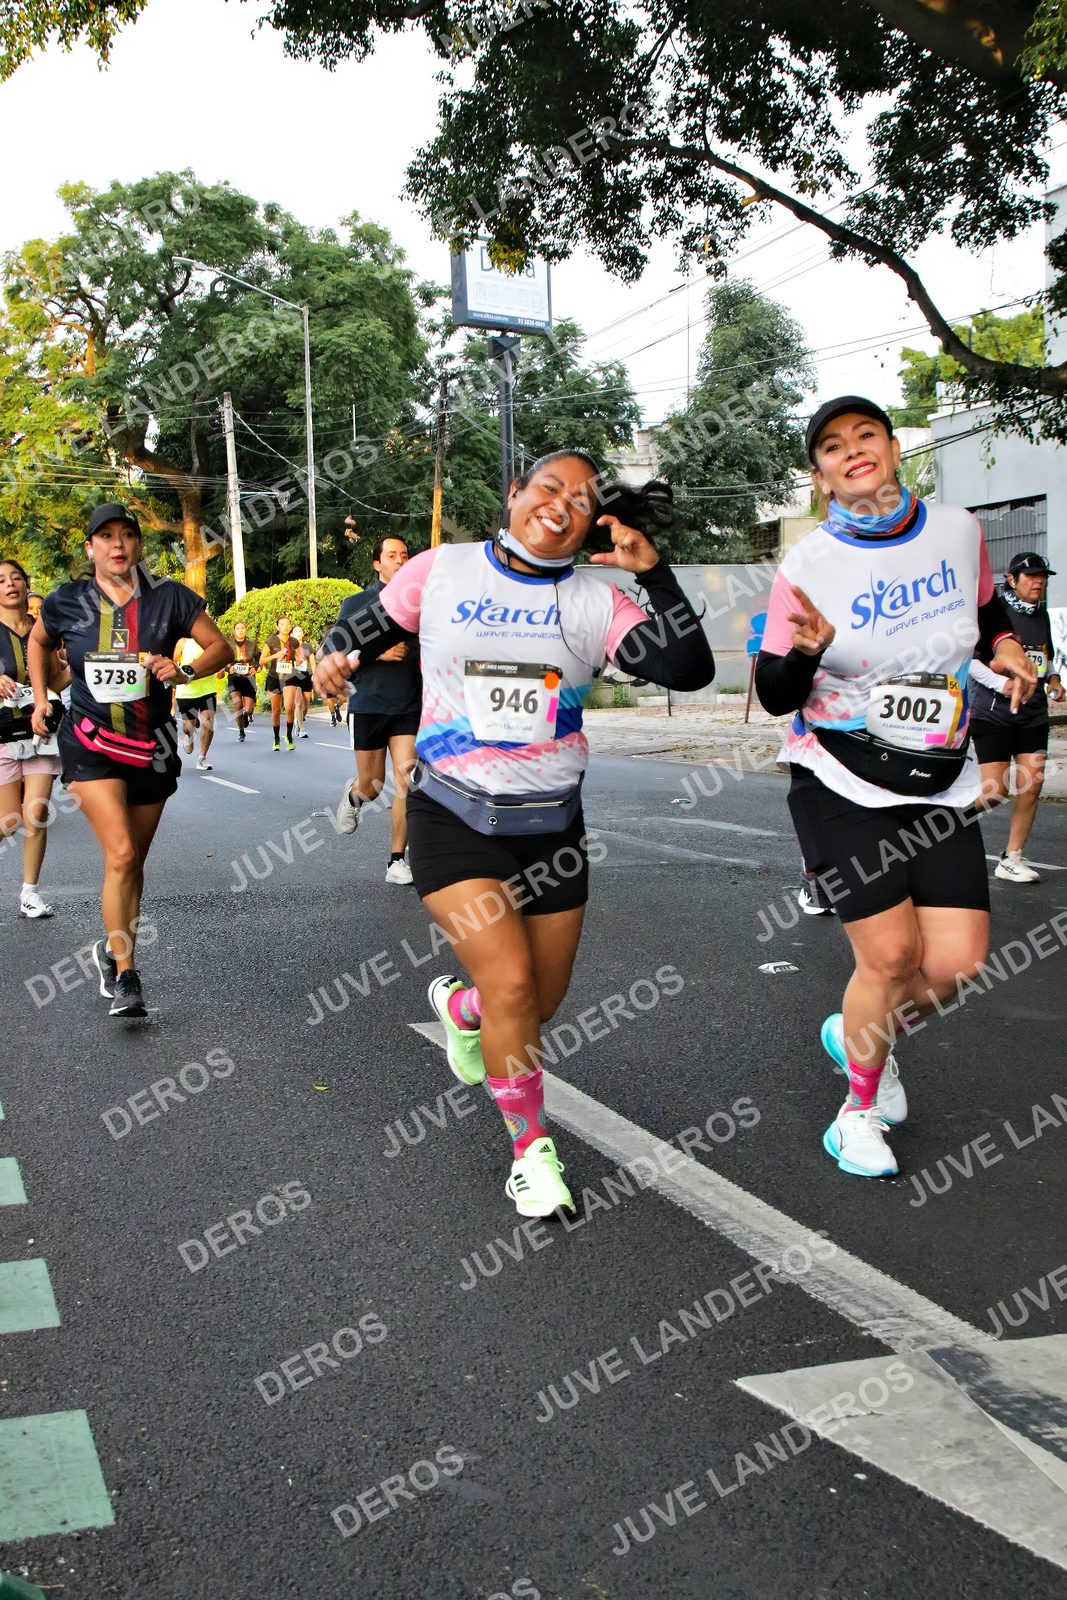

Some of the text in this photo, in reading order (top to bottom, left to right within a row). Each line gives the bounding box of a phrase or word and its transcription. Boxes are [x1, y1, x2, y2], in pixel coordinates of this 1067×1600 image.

[886, 598, 966, 636] WAVE RUNNERS
[511, 631, 561, 640] RUNNERS
[93, 669, 137, 685] 3738
[949, 681, 958, 690] 5K
[490, 687, 539, 714] 946
[880, 695, 942, 724] 3002
